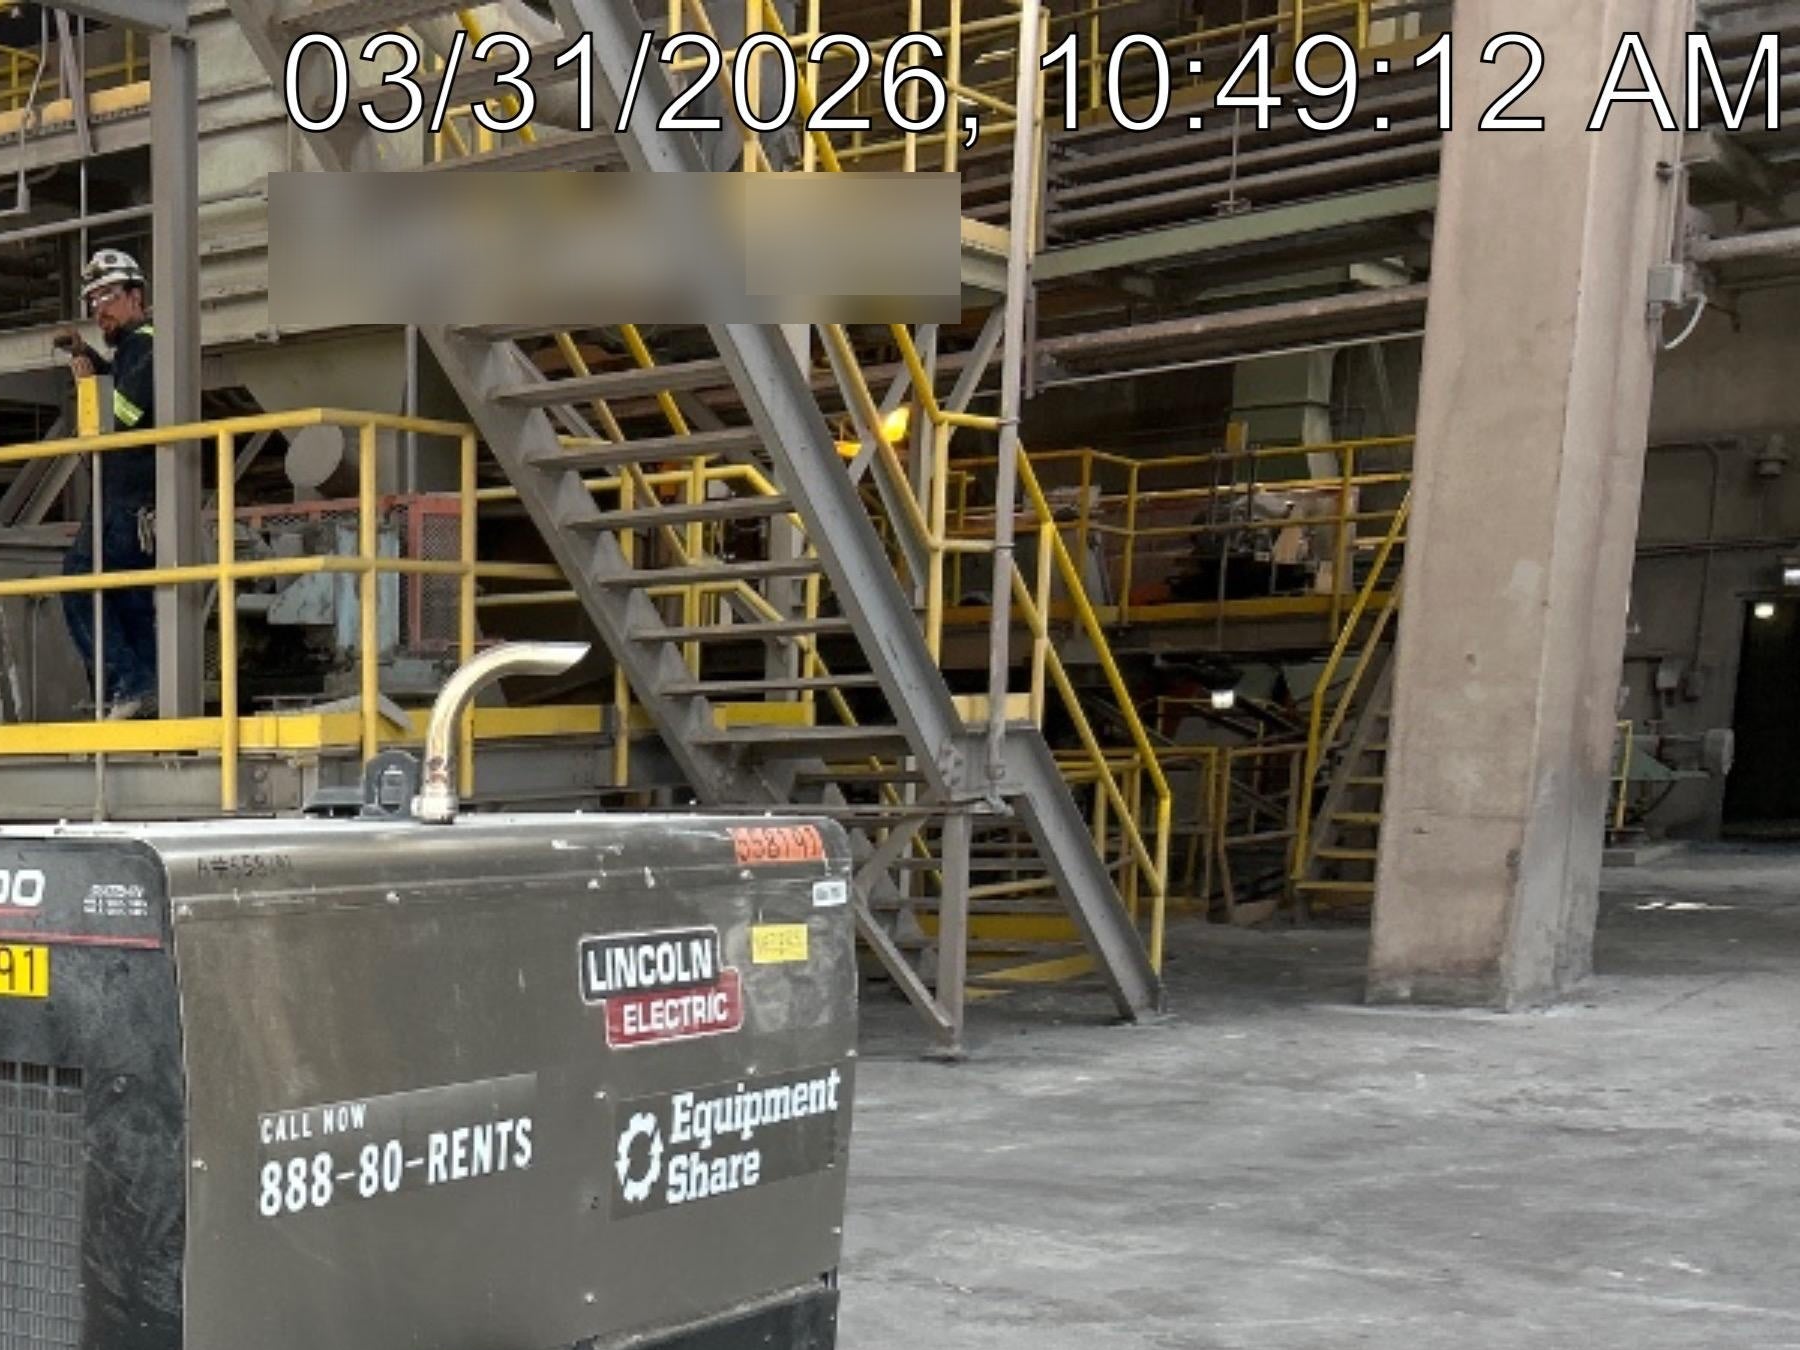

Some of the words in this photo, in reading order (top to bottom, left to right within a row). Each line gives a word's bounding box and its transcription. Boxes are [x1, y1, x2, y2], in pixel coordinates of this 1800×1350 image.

[587, 938, 713, 992] LINCOLN
[622, 992, 728, 1036] ELECTRIC
[259, 1114, 313, 1145] CALL
[323, 1103, 368, 1135] NOW
[668, 1067, 841, 1150] Equipment
[259, 1116, 533, 1217] 888-80-RENTS
[665, 1149, 761, 1205] Share
